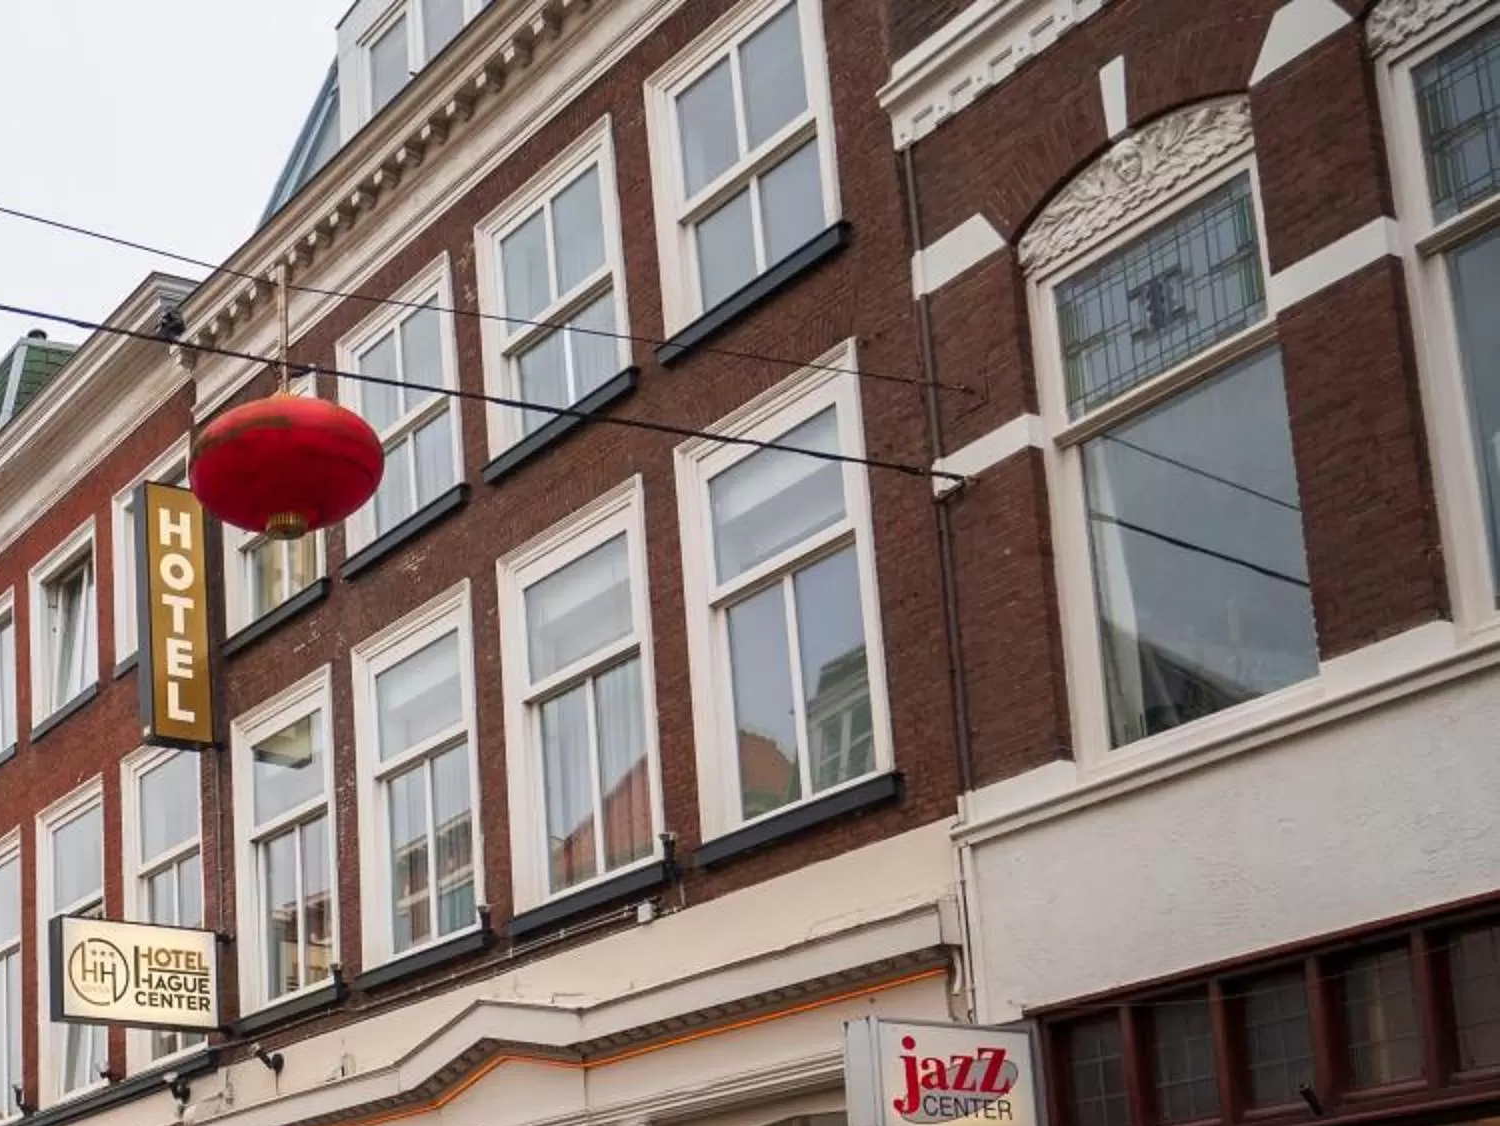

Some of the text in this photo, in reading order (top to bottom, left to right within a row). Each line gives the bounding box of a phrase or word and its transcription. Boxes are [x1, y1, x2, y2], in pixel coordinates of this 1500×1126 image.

[159, 507, 195, 723] HOTEL
[135, 946, 210, 971] HOTEL
[135, 973, 211, 995] HAGUE
[134, 991, 211, 1012] CENTER
[923, 1095, 1013, 1121] CENTER
